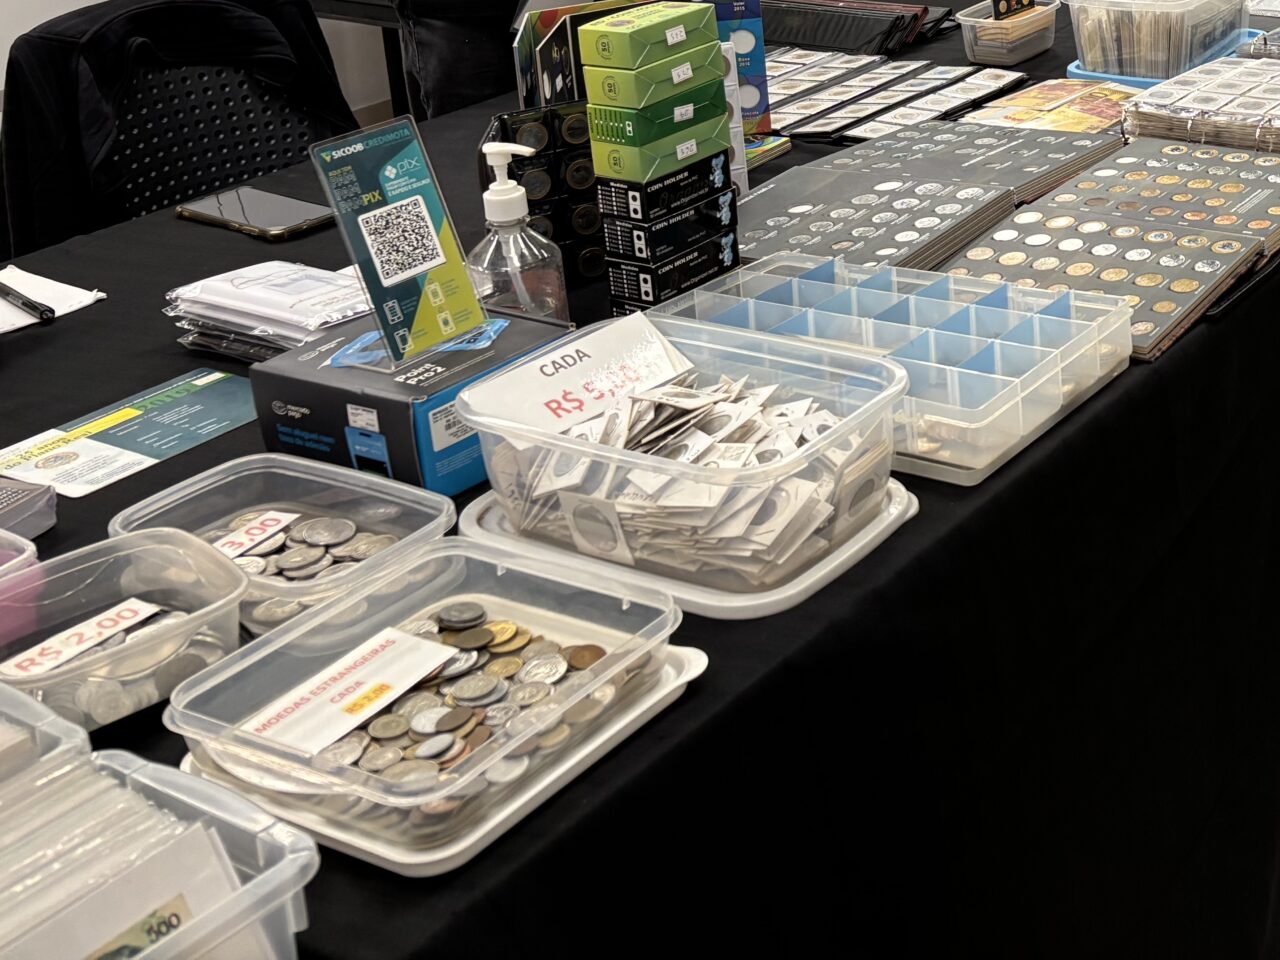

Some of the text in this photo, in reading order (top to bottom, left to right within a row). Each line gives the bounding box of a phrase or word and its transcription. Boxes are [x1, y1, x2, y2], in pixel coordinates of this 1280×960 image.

[331, 143, 365, 160] SICOOB
[396, 156, 421, 175] pix
[647, 182, 663, 193] COIN
[664, 171, 689, 186] HOLDER
[362, 189, 383, 206] PIX
[651, 221, 668, 231] COIN
[669, 209, 695, 225] HOLDER
[658, 251, 699, 275] COIN HOLDER
[394, 362, 436, 383] Point
[539, 348, 592, 377] CADA
[544, 389, 585, 419] R$
[220, 517, 282, 551] 3,00
[15, 607, 140, 673] R$ 2,00
[254, 639, 396, 734] MOEDAS ESTRANGEIRAS
[329, 679, 365, 705] CADA
[145, 913, 181, 944] 500
